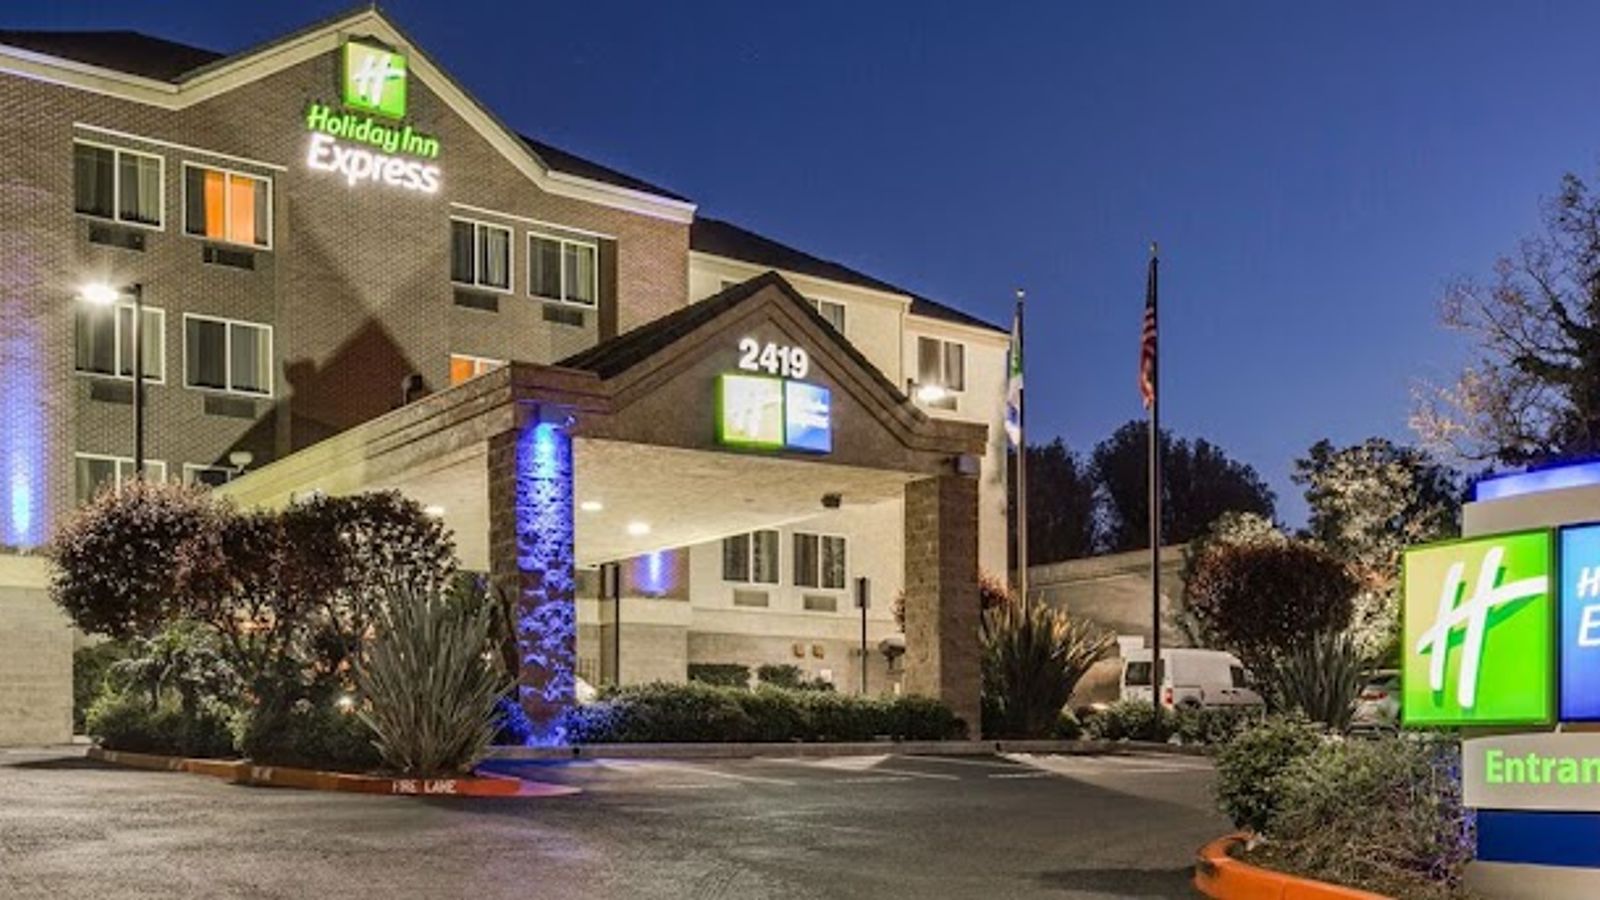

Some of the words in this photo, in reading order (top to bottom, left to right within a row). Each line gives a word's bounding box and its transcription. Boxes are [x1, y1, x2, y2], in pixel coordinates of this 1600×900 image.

[307, 104, 399, 153] Holiday
[402, 126, 440, 158] Inn
[307, 132, 441, 193] Express
[738, 337, 809, 379] 2419
[1416, 545, 1549, 709] H
[392, 779, 418, 794] FIRE
[424, 779, 457, 794] LANE
[1485, 749, 1600, 784] Entran
